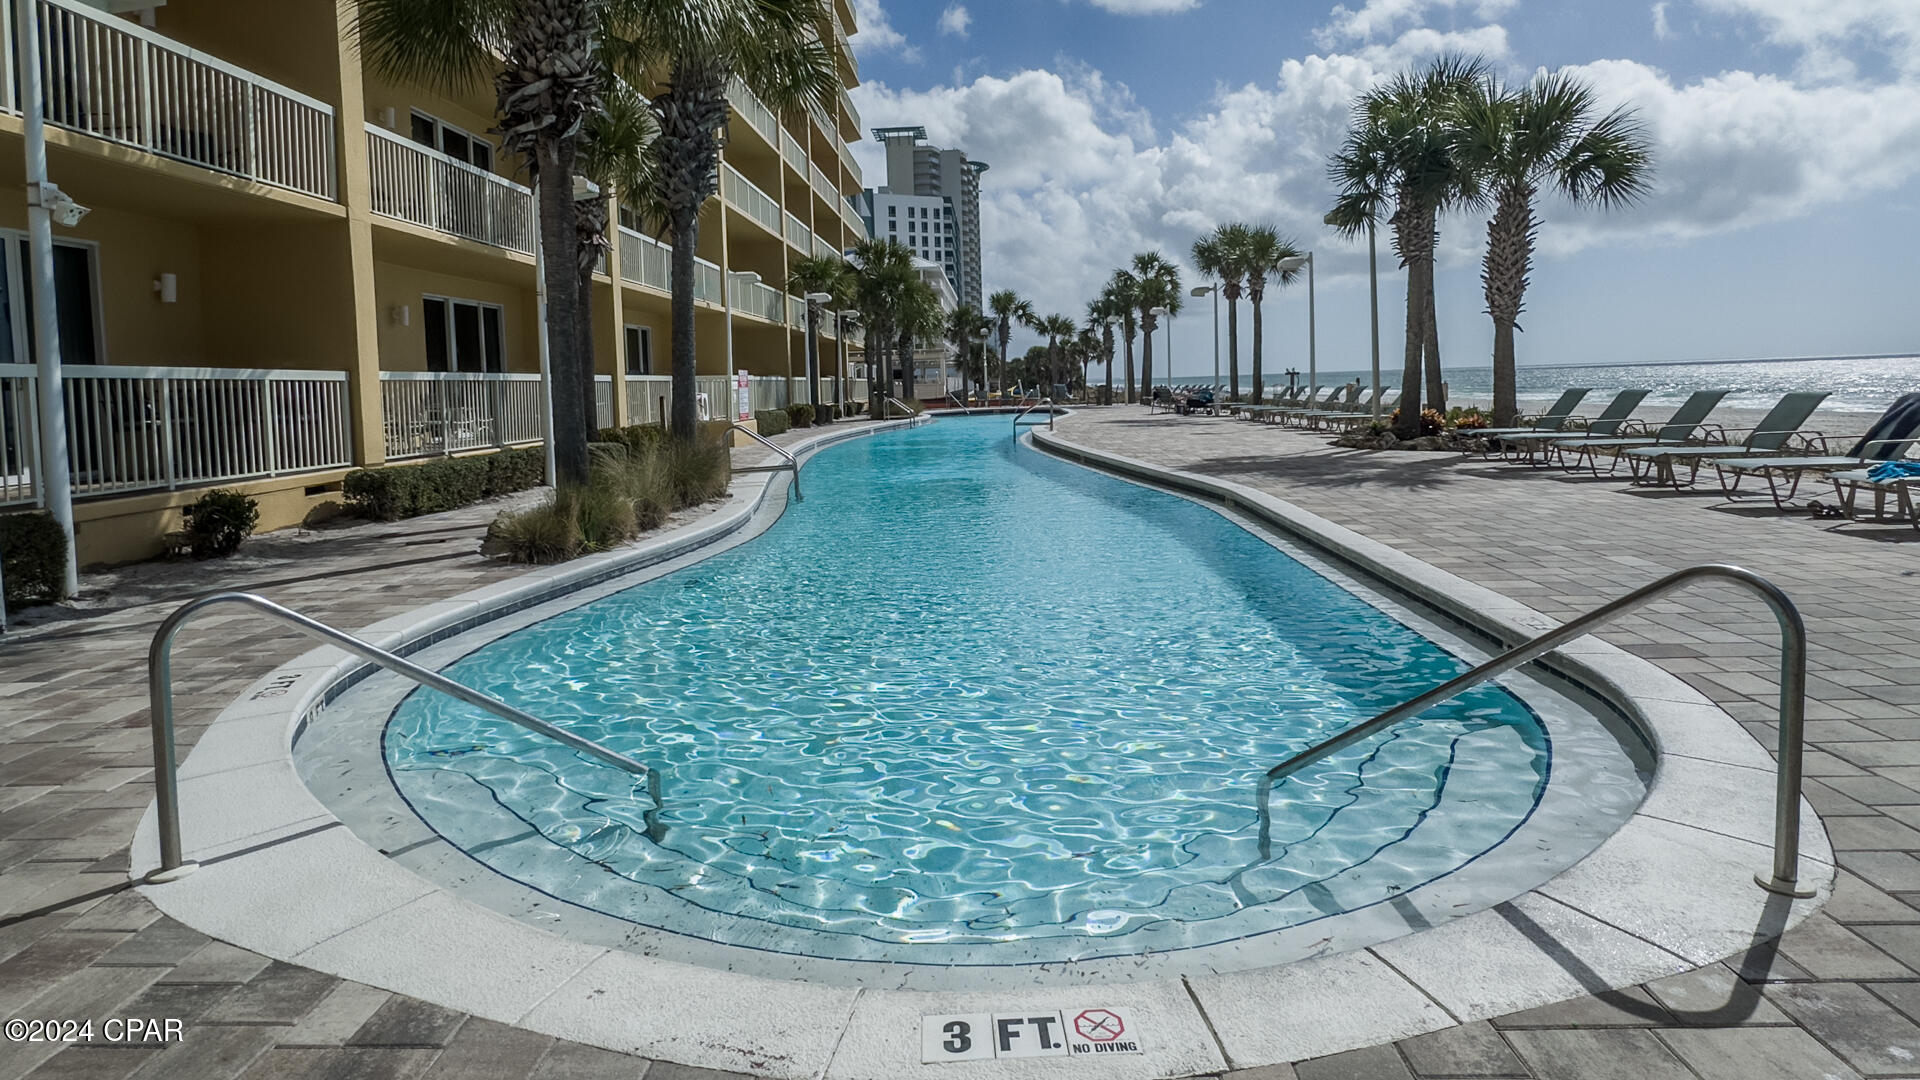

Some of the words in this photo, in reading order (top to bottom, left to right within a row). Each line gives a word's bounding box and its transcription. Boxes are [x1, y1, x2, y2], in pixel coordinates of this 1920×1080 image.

[943, 1020, 972, 1053] 3
[997, 1016, 1061, 1052] FT.
[1072, 1043, 1091, 1054] NO
[1095, 1042, 1137, 1053] DIVING
